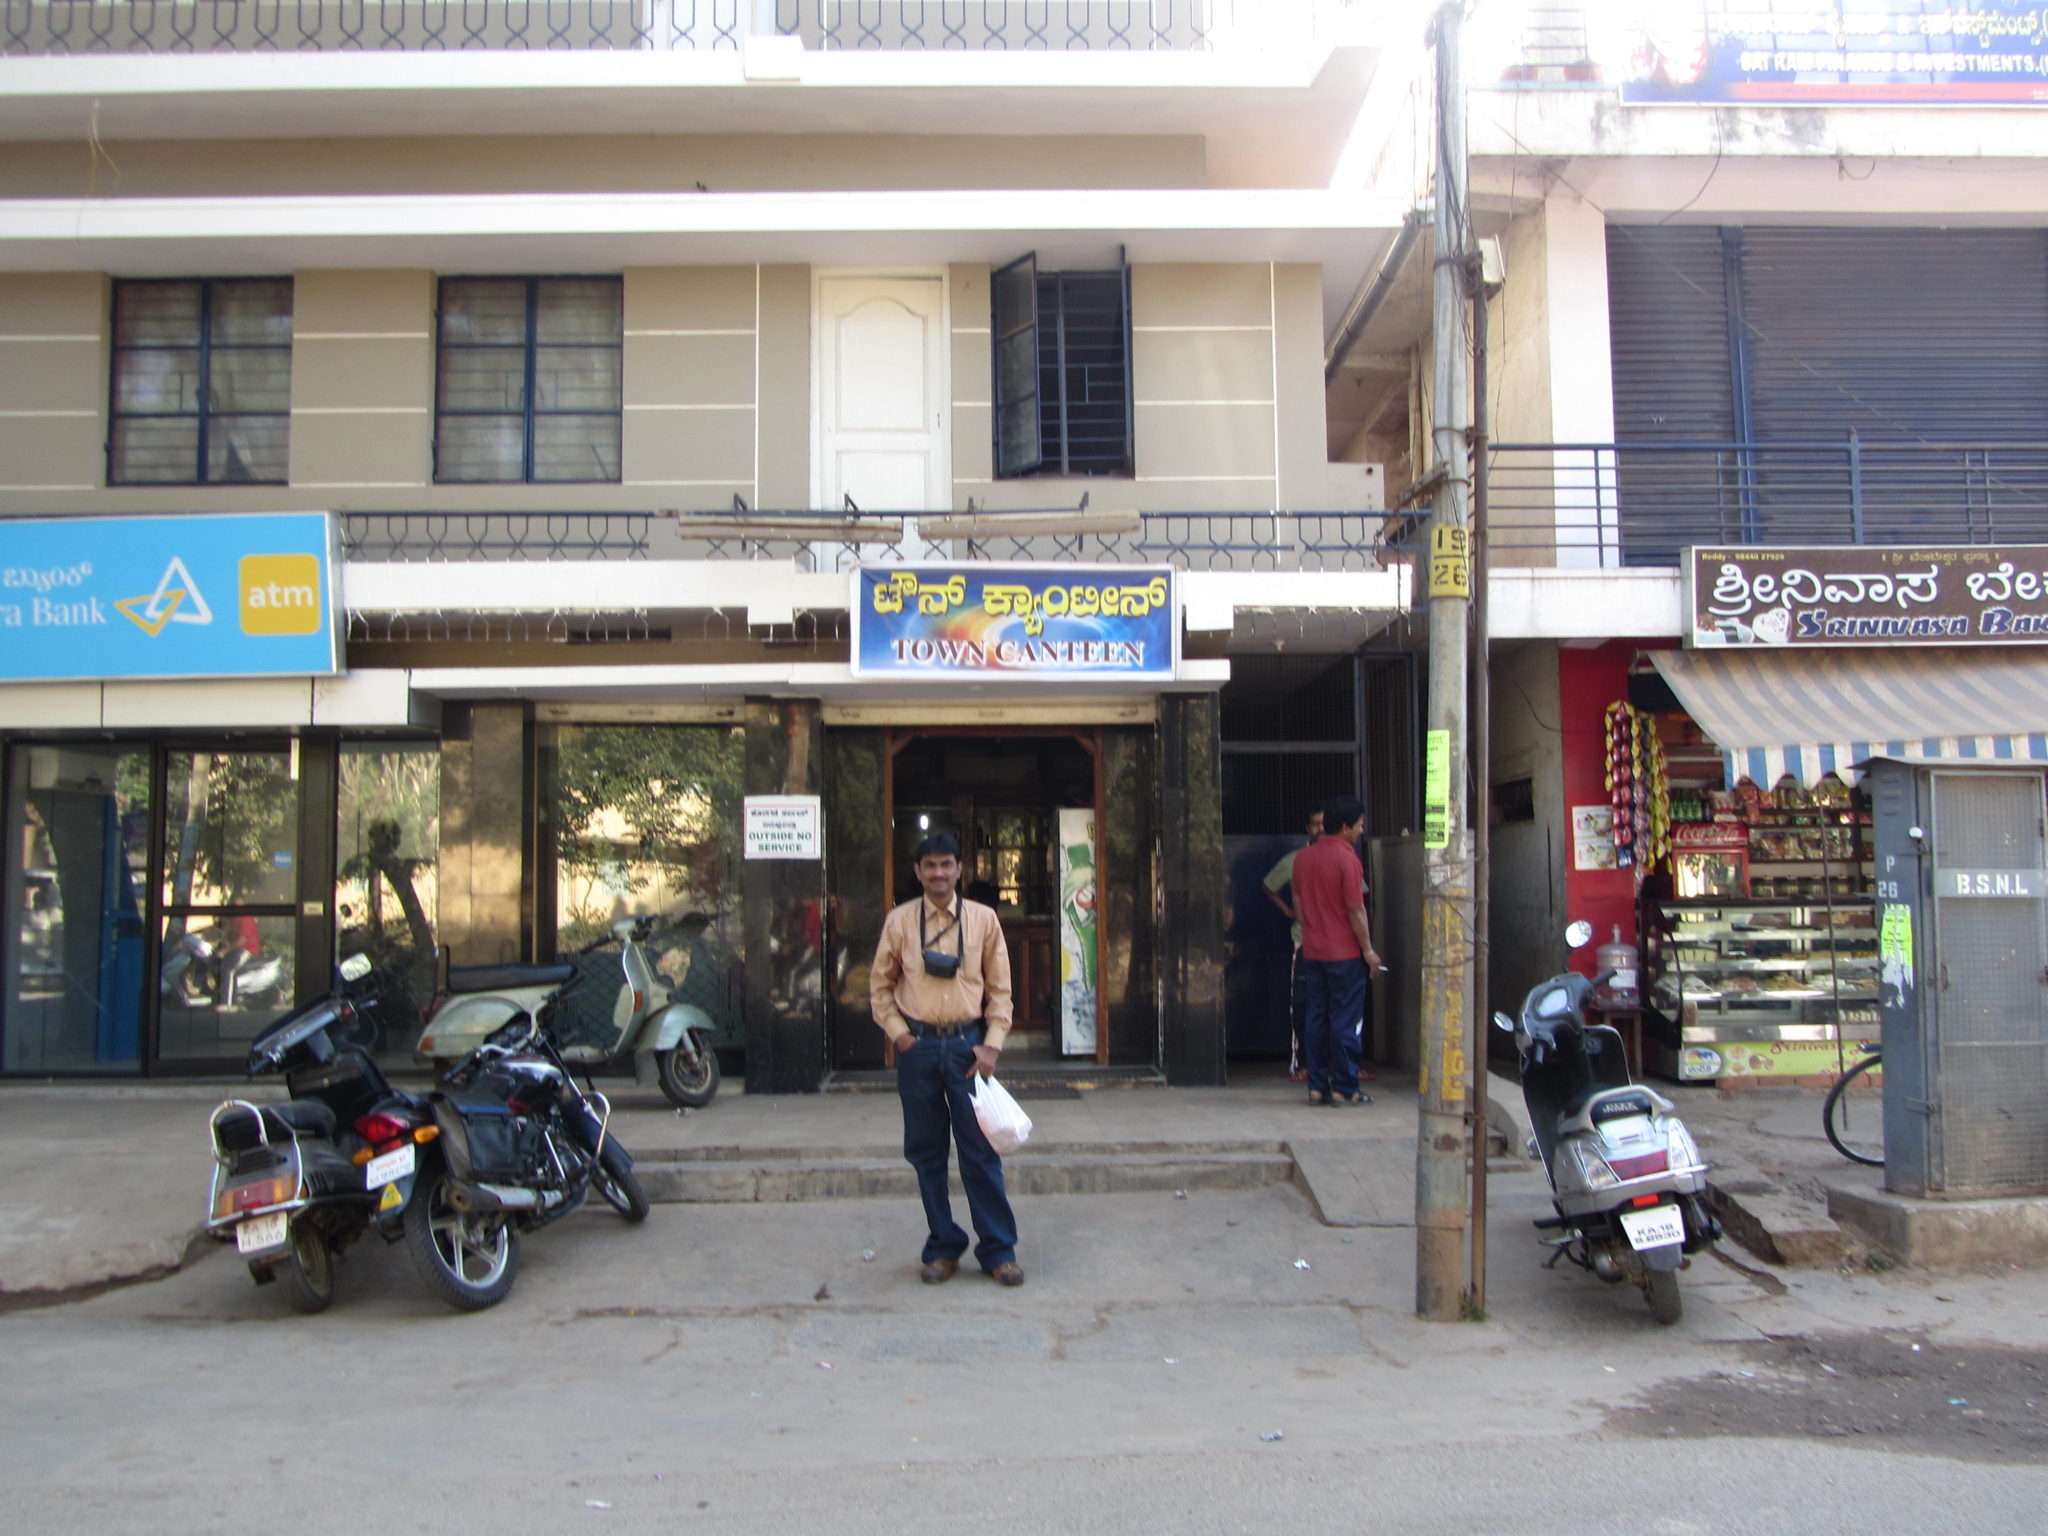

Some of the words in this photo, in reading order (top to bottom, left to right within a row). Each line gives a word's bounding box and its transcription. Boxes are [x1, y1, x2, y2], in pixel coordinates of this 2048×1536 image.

[248, 583, 314, 609] atm
[1707, 562, 1939, 617] ಶ್ರೀನಿವಾಸ
[32, 596, 107, 626] Bank
[873, 571, 967, 616] ಟೌನ್
[982, 575, 1168, 637] ಕ್ಯಾಂಟೀನ್
[891, 638, 986, 666] TOWN
[995, 638, 1145, 667] CANTEEN
[748, 832, 794, 841] OUTSIDE
[797, 832, 812, 841] NO
[758, 843, 802, 853] SERVICE
[1885, 855, 1896, 873] P
[1877, 881, 1898, 899] 26
